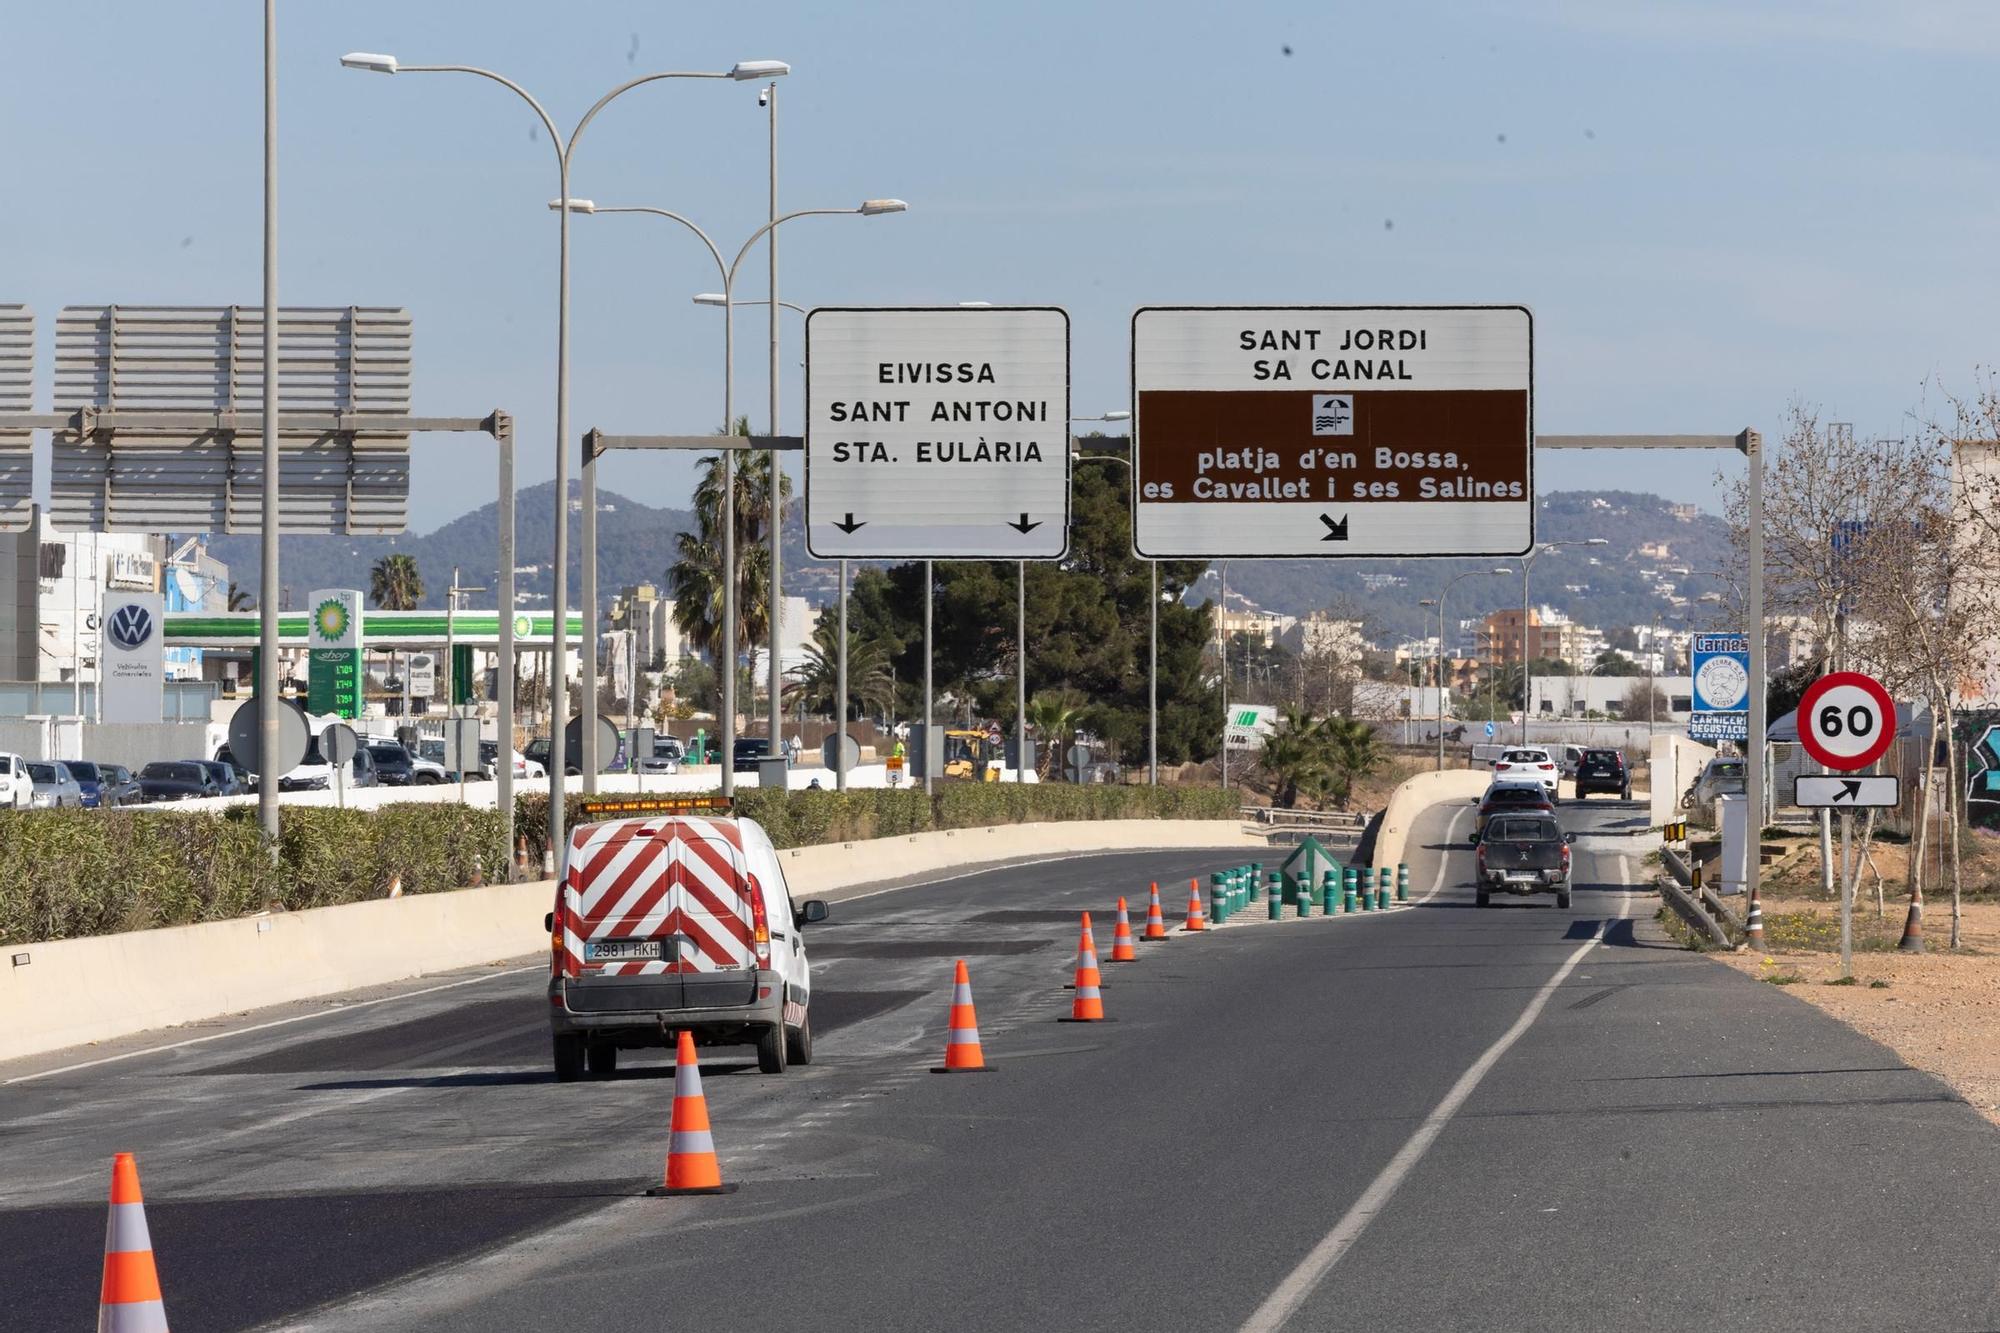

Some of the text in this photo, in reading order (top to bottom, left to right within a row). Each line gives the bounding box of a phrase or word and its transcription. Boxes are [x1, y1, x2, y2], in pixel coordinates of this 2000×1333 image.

[1240, 329, 1426, 351] SANT JORDI
[879, 363, 995, 383] EIVISSA
[1253, 359, 1412, 380] SA CANAL
[830, 401, 1047, 422] SANT ANTONI
[833, 437, 1042, 462] STA. EULÀRIA
[1198, 447, 1469, 473] platja d'en Bossa,
[1143, 476, 1522, 499] es Cavallet i ses Salines
[321, 650, 350, 660] shop
[1695, 636, 1749, 653] Carnes
[1691, 715, 1747, 725] CARNICERI
[1691, 724, 1747, 734] DEGUSTACIO
[1820, 706, 1872, 737] 60
[594, 944, 625, 957] 2981
